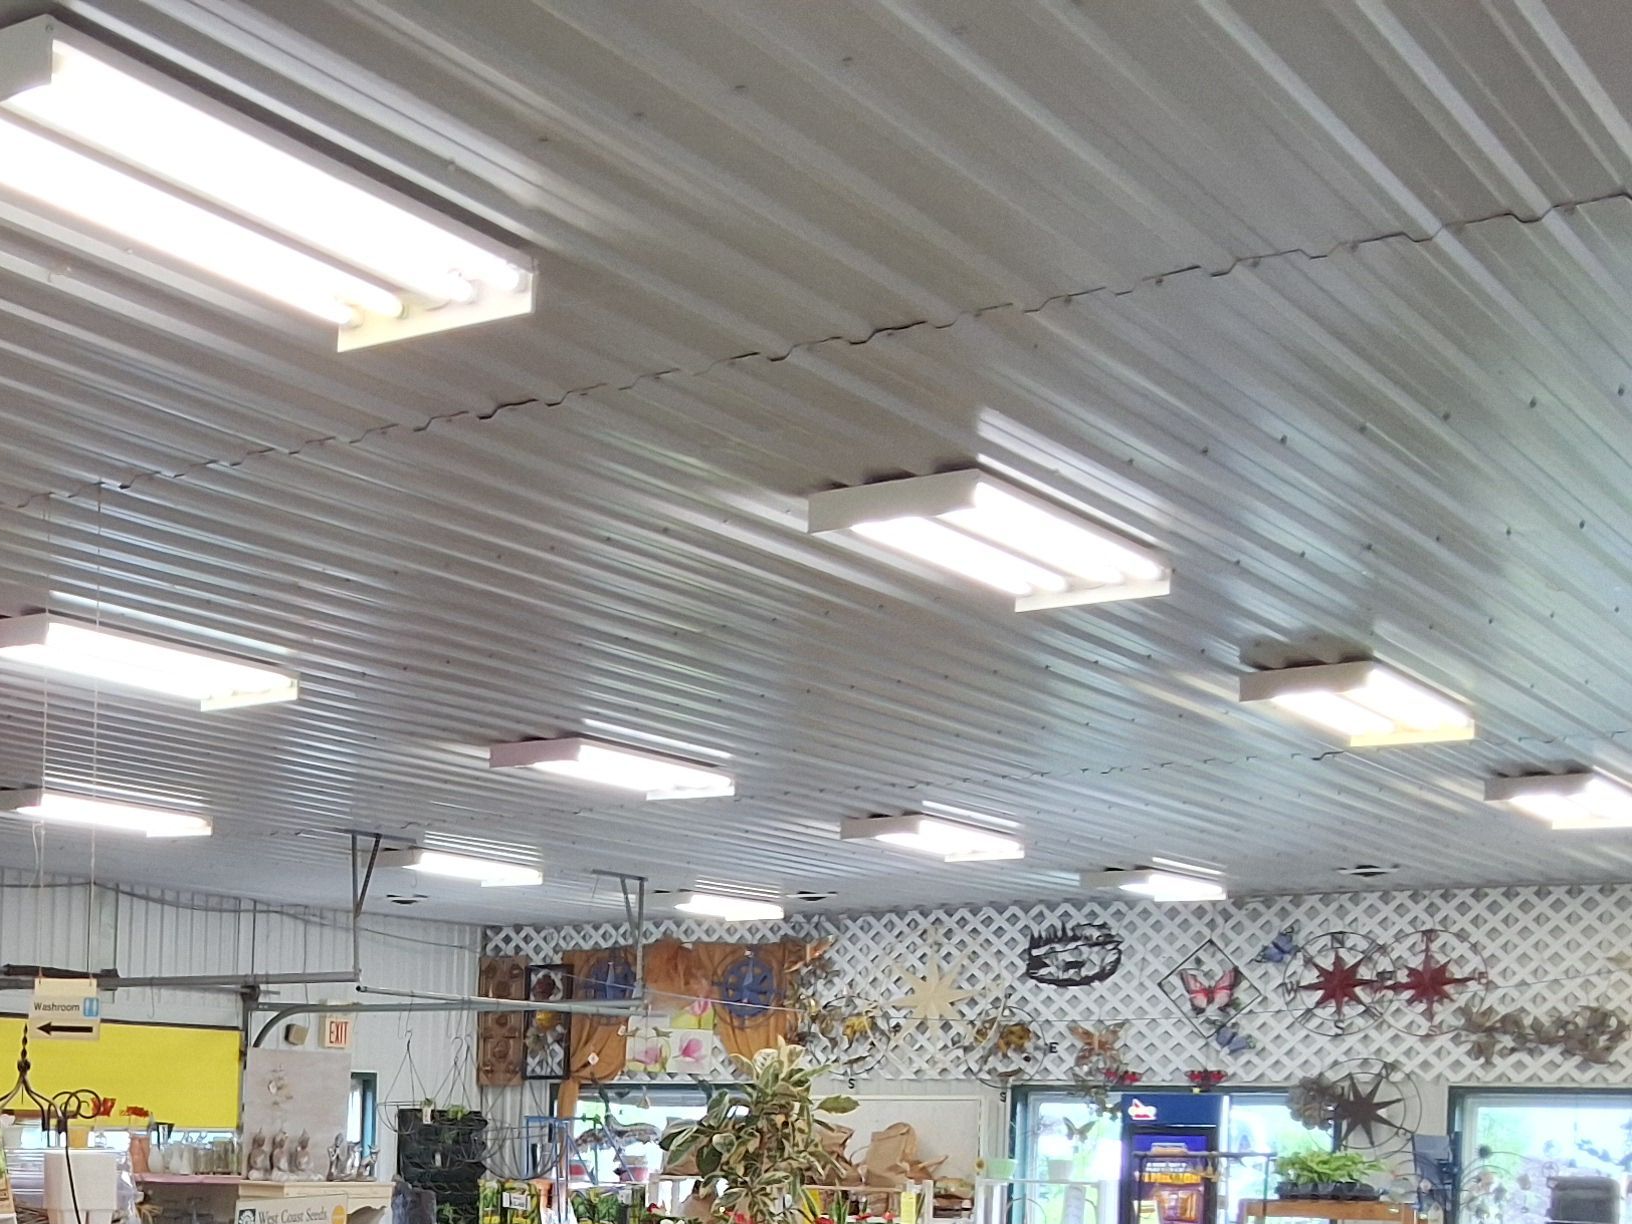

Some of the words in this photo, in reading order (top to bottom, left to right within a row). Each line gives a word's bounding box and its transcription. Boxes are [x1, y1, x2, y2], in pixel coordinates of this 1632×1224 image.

[33, 1002, 80, 1013] Washroom
[328, 1019, 349, 1045] EXIT
[258, 1210, 280, 1224] West
[280, 1209, 304, 1224] Coast
[305, 1206, 328, 1222] Seeds
